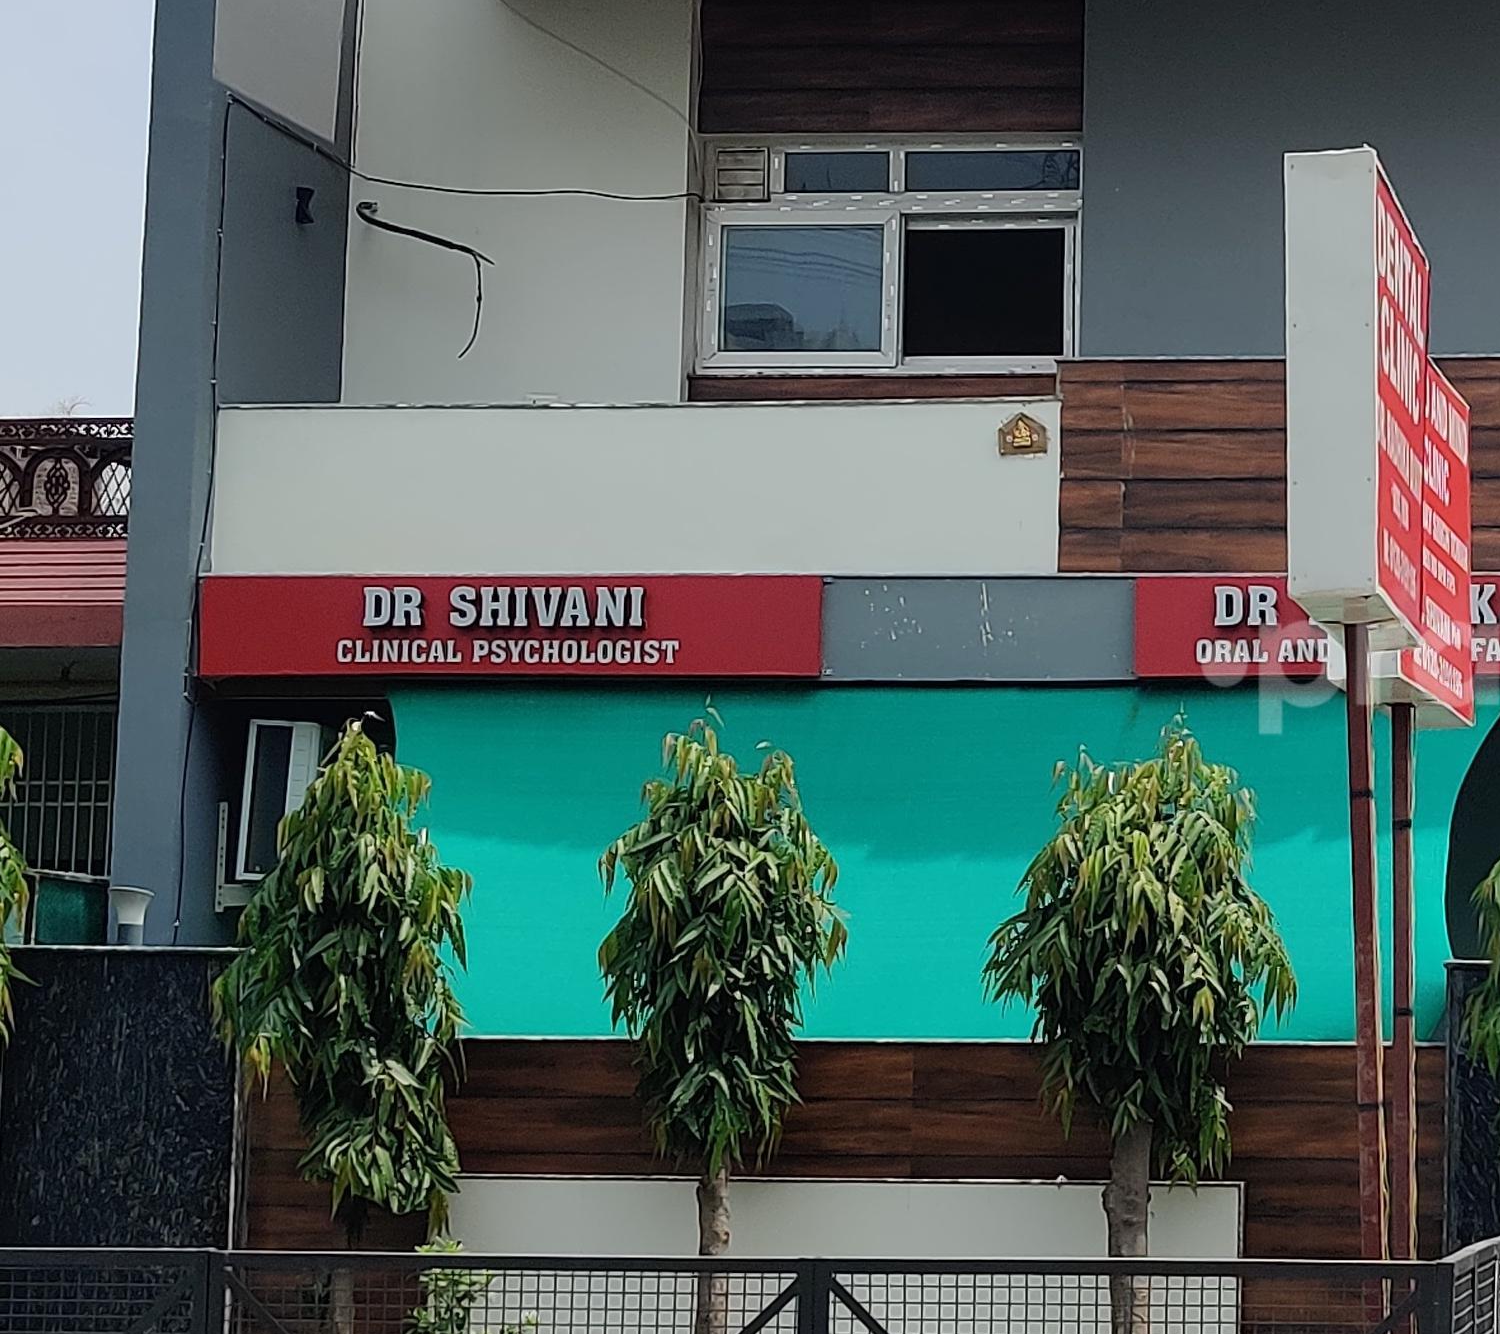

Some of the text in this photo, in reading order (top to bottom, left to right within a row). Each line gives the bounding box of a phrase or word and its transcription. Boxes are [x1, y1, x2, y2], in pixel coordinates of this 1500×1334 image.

[1377, 194, 1424, 351] DENTAL
[1381, 295, 1420, 425] CLINIC
[362, 585, 646, 628] DR SHIVANI
[1214, 586, 1277, 626] DR
[336, 639, 680, 665] CLINICAL PSYCHOLOGIST
[1196, 639, 1268, 663] ORAL
[1277, 638, 1329, 662] AND
